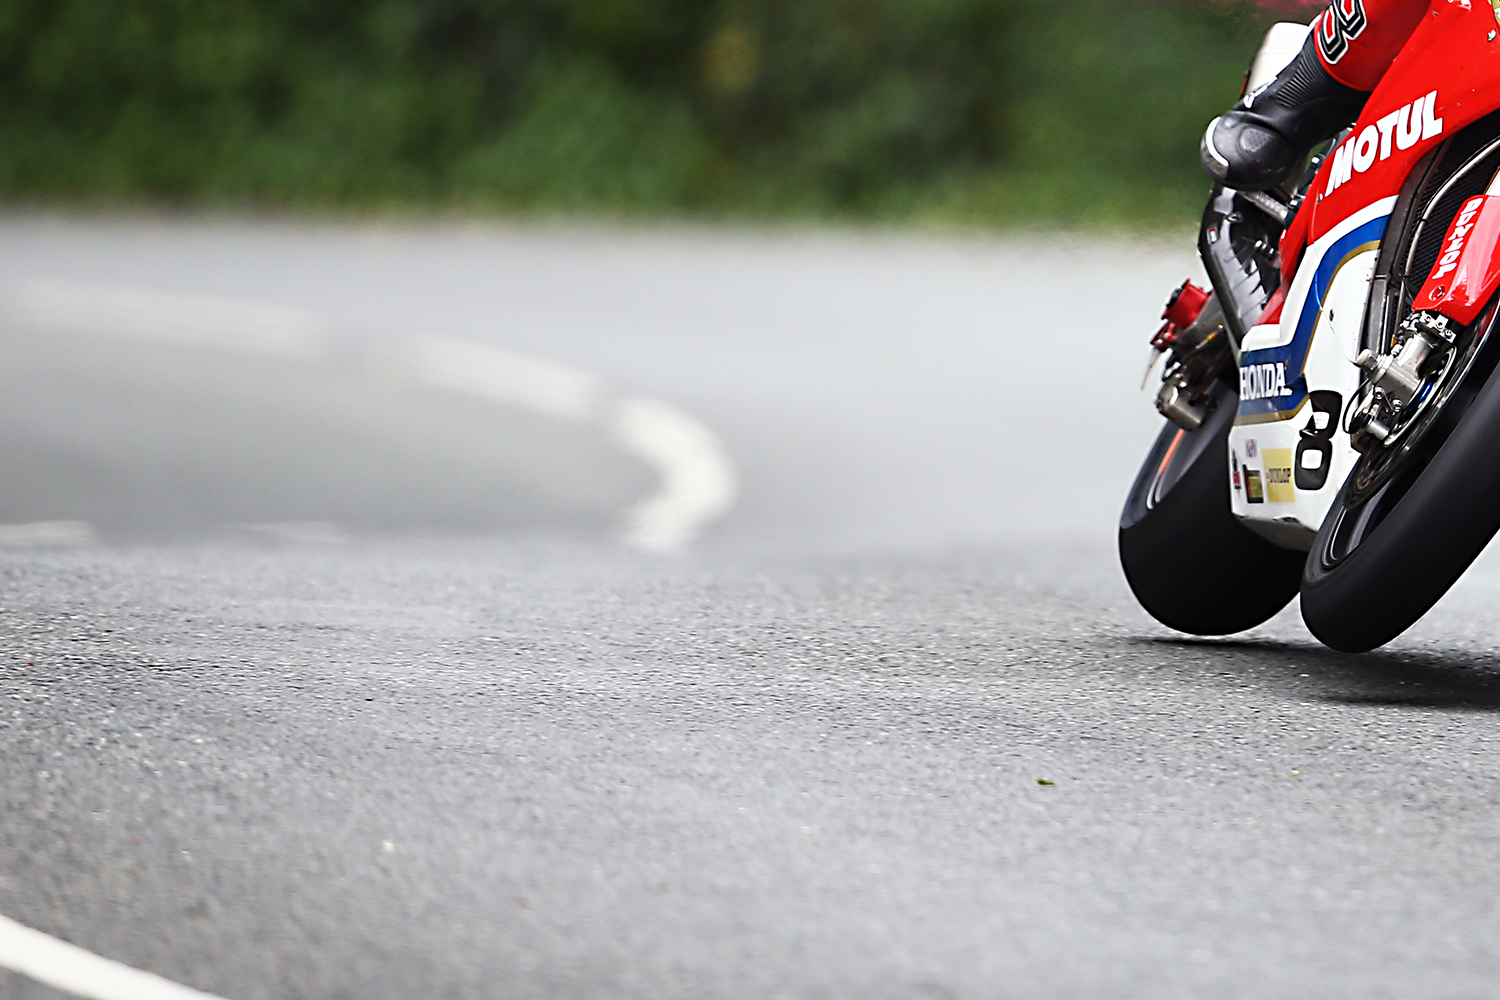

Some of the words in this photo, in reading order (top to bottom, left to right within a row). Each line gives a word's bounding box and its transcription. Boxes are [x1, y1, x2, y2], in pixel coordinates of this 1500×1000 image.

[1325, 91, 1444, 197] MOTUL
[1240, 363, 1293, 400] HONDA
[1294, 390, 1342, 490] 8
